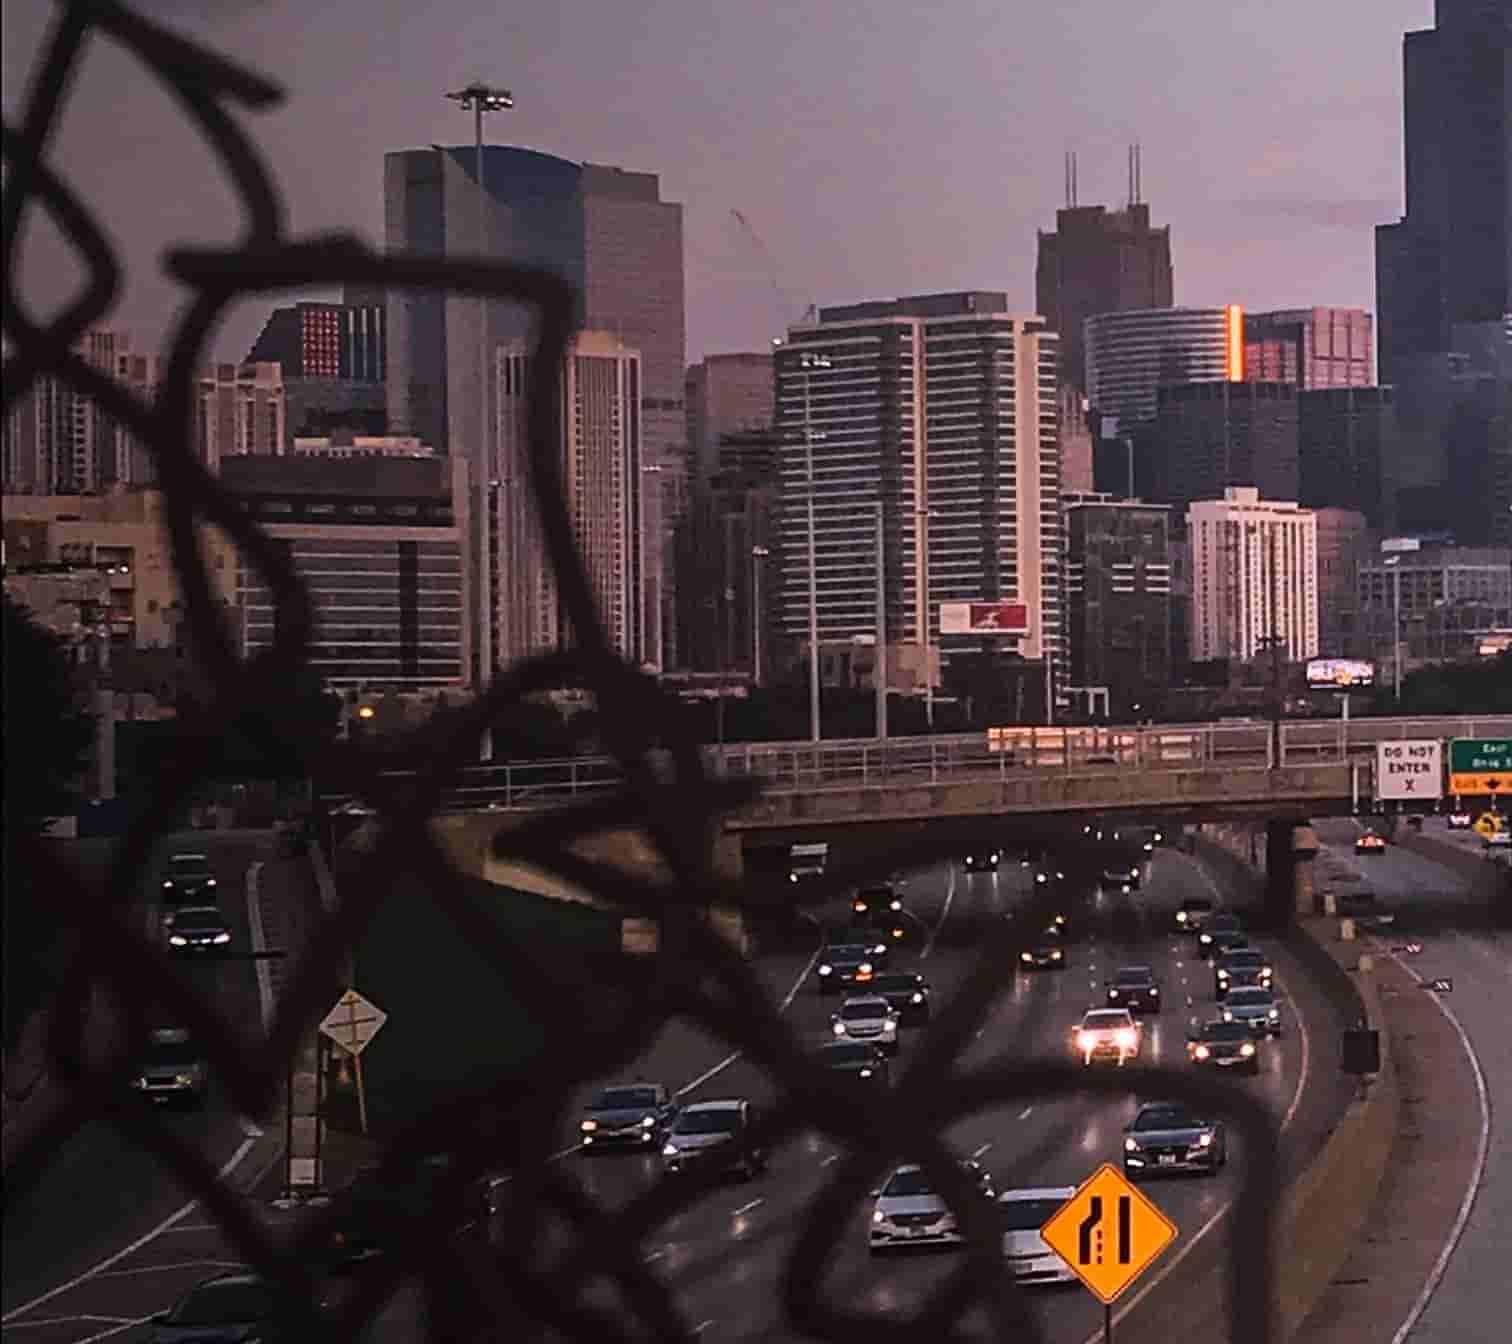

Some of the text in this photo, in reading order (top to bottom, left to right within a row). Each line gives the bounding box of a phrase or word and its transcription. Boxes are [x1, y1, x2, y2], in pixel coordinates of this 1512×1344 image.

[1384, 745, 1435, 757] DO NOT
[1388, 761, 1431, 774] ENTER
